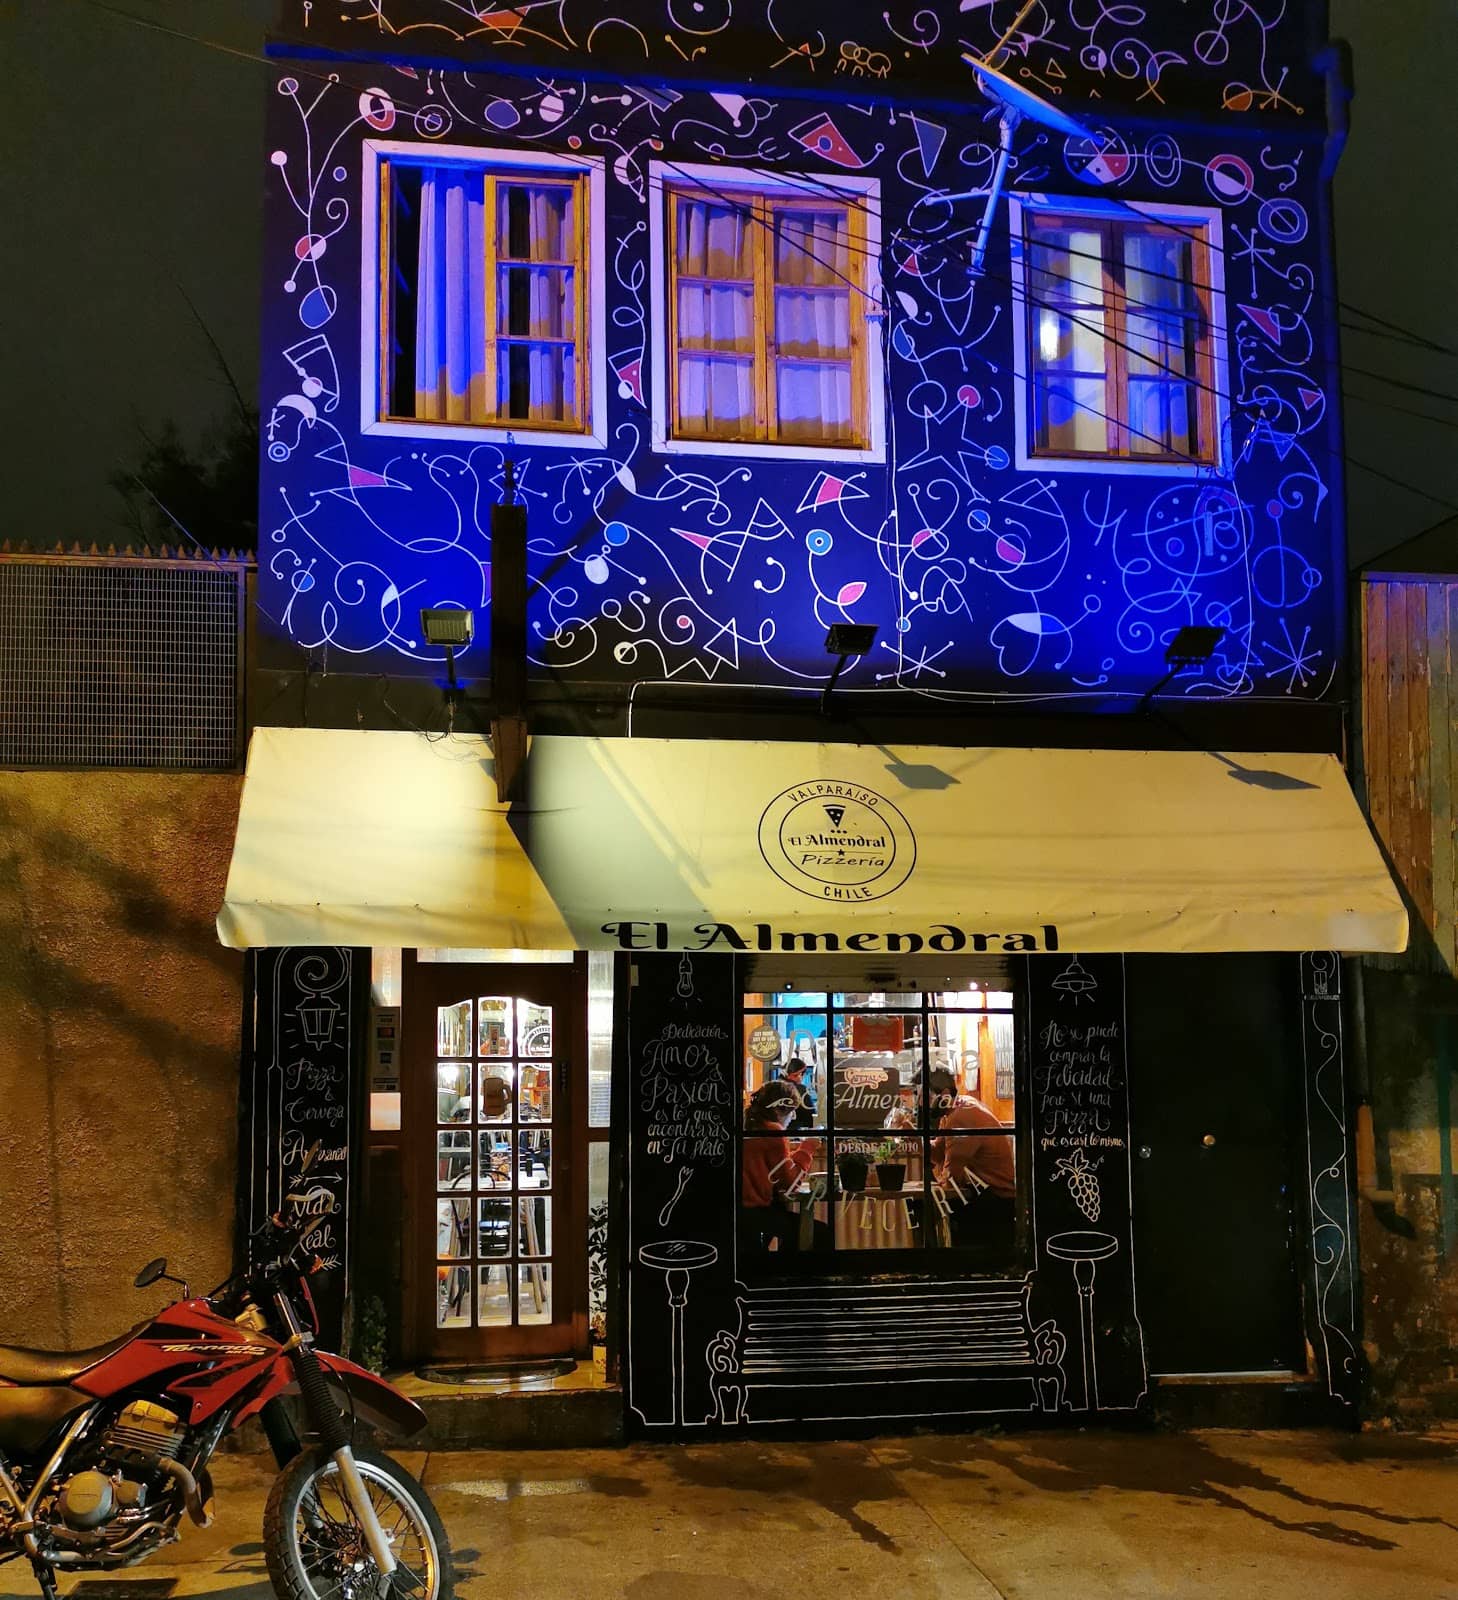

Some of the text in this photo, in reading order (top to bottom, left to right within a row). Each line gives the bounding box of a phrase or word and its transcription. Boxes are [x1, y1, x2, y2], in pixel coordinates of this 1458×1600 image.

[787, 784, 879, 806] VALPARAISO
[788, 834, 886, 848] El Almendral
[801, 853, 885, 867] Pizzería
[823, 886, 873, 899] CHILE
[600, 922, 1059, 953] El Almendral
[640, 1040, 717, 1076] Amor
[161, 1344, 267, 1352] Tornado
